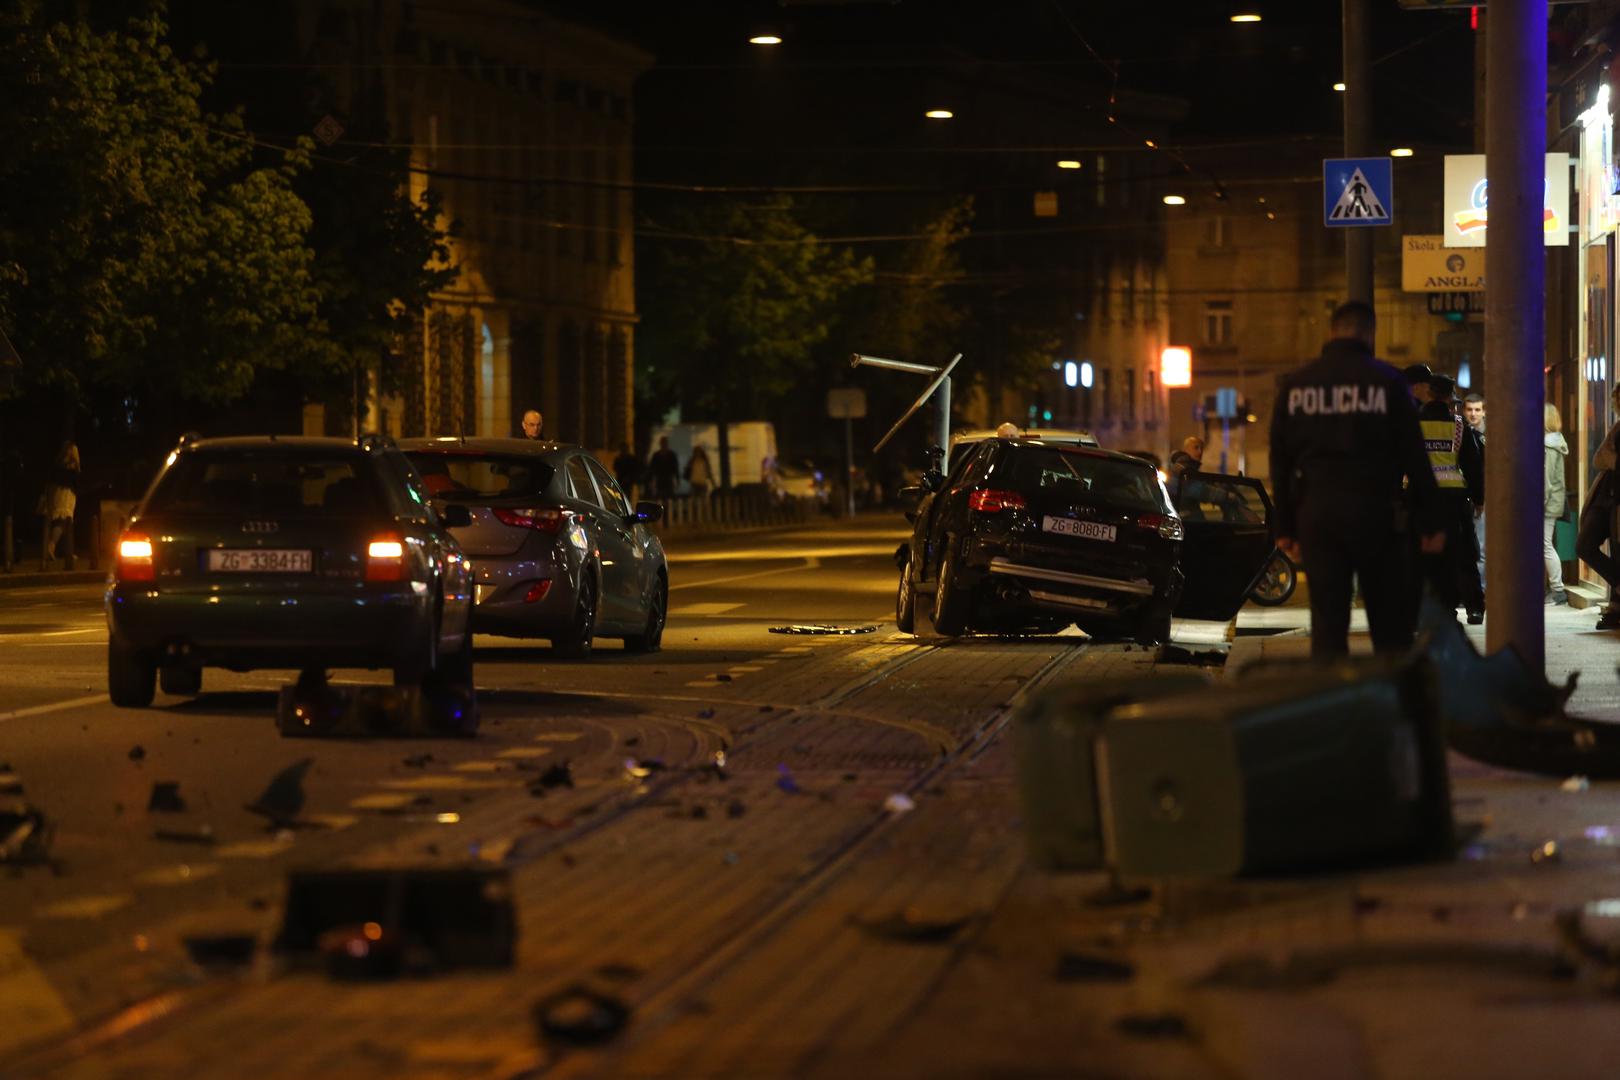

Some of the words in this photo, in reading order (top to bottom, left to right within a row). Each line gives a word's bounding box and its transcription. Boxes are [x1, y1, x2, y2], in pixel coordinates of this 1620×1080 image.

[1288, 384, 1387, 416] POLICIJA
[1051, 518, 1065, 532] ZG
[221, 552, 240, 569] ZG
